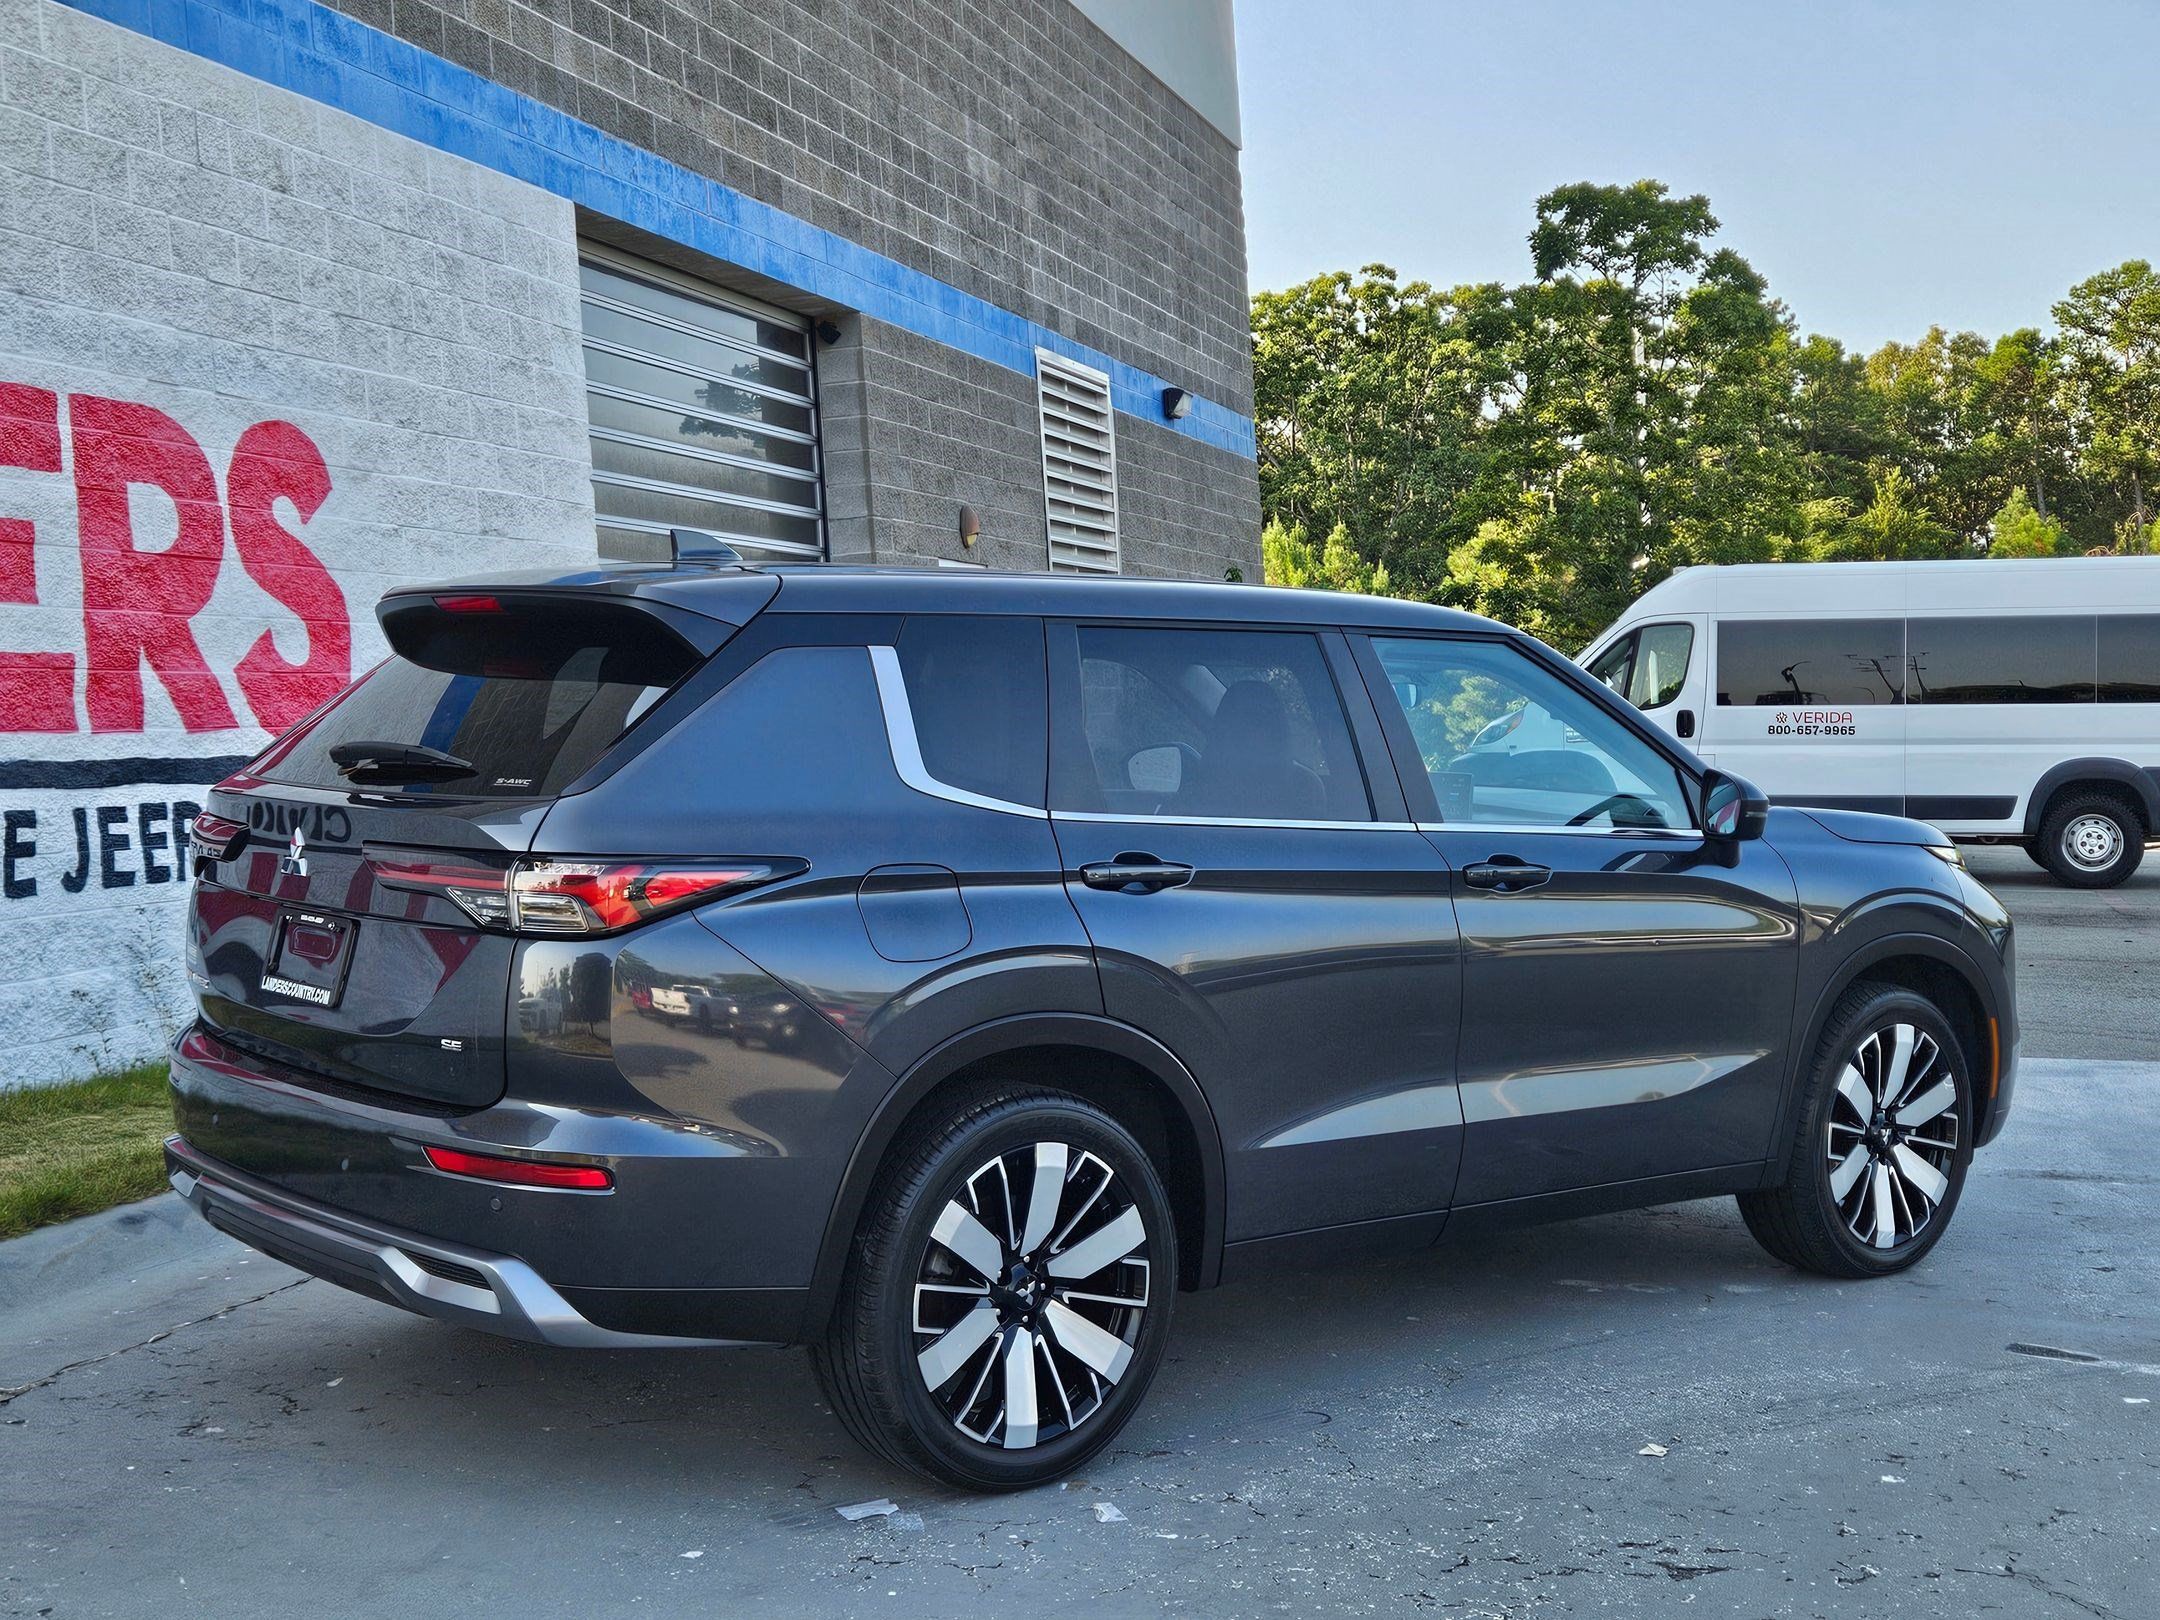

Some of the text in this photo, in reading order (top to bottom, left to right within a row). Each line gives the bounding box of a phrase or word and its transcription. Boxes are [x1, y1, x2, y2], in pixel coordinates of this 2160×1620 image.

[1792, 711, 1853, 724] VERIDA
[1767, 724, 1856, 736] 800-657-9965
[3, 809, 37, 899] E
